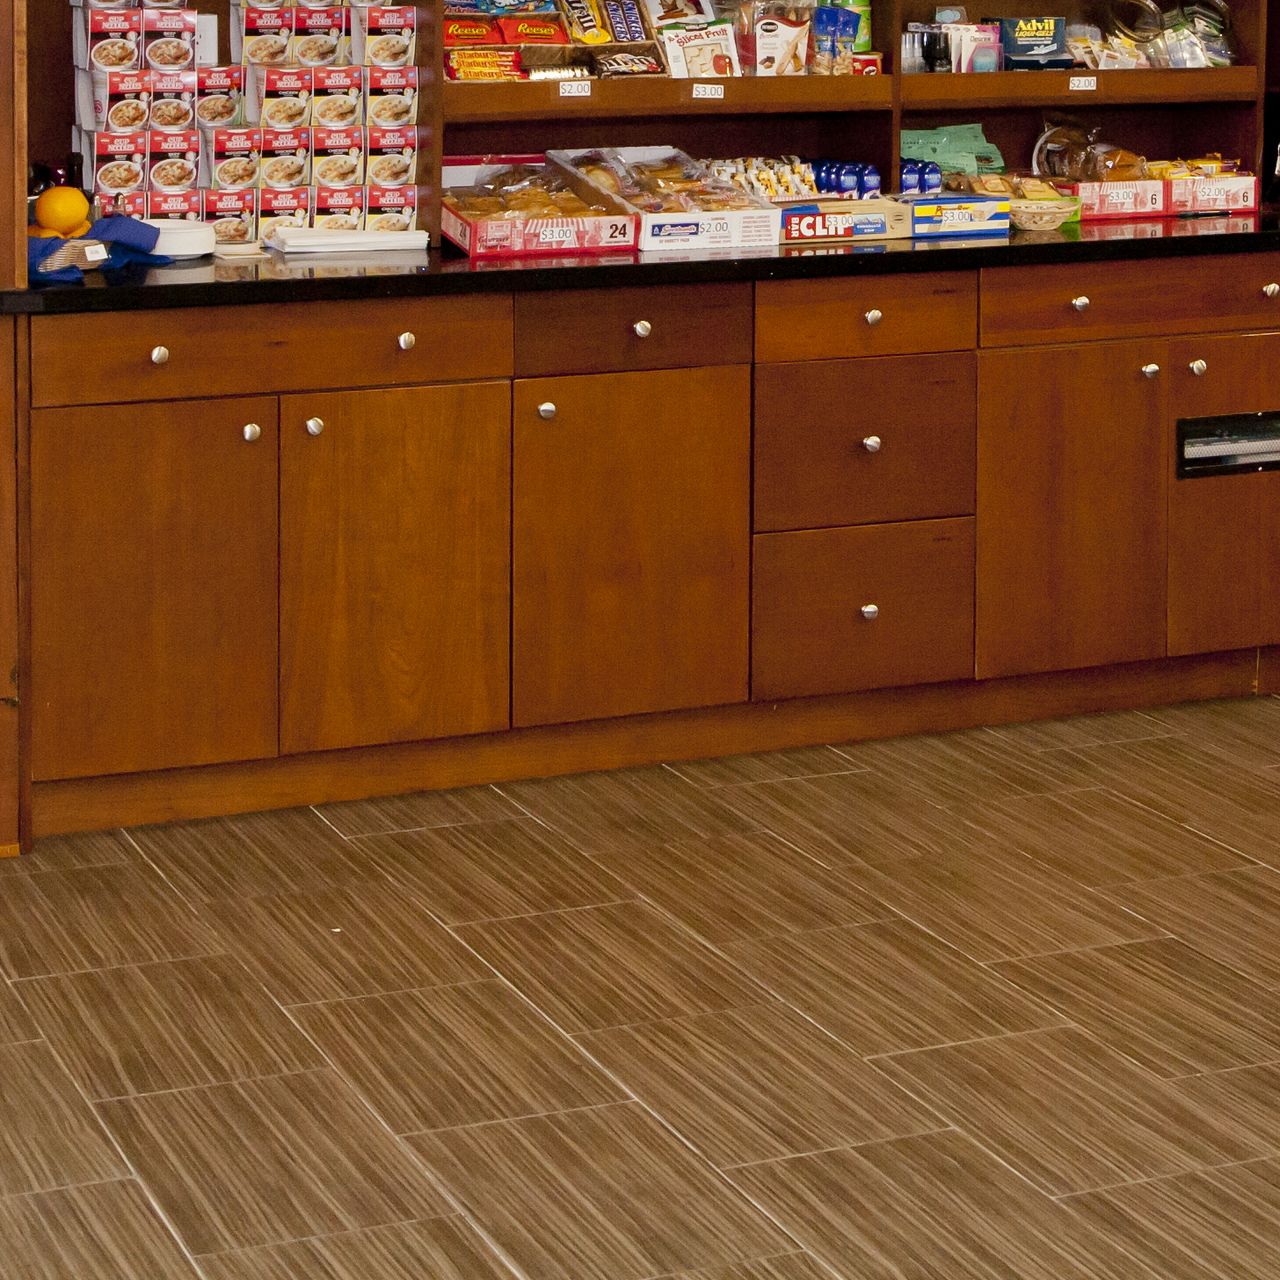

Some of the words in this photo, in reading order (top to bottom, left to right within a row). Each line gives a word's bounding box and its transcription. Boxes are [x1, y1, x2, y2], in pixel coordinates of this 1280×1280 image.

[606, 1, 630, 40] SNICKERS
[622, 1, 644, 40] SNICKERS
[1015, 20, 1055, 31] Advil
[676, 34, 704, 48] Sliced
[706, 28, 728, 38] Fruit
[560, 83, 590, 94] $2.00
[1070, 78, 1096, 88] $2.00
[694, 86, 723, 97] $3.00
[1109, 191, 1133, 201] $3.00
[1202, 187, 1225, 197] $2.00
[1242, 192, 1249, 203] 6
[1151, 194, 1157, 205] 6
[827, 216, 854, 227] $3.00
[943, 212, 970, 222] $3.00
[609, 223, 628, 239] 24
[700, 222, 728, 233] $2.00
[788, 217, 799, 238] BAR
[541, 229, 571, 240] $3.00
